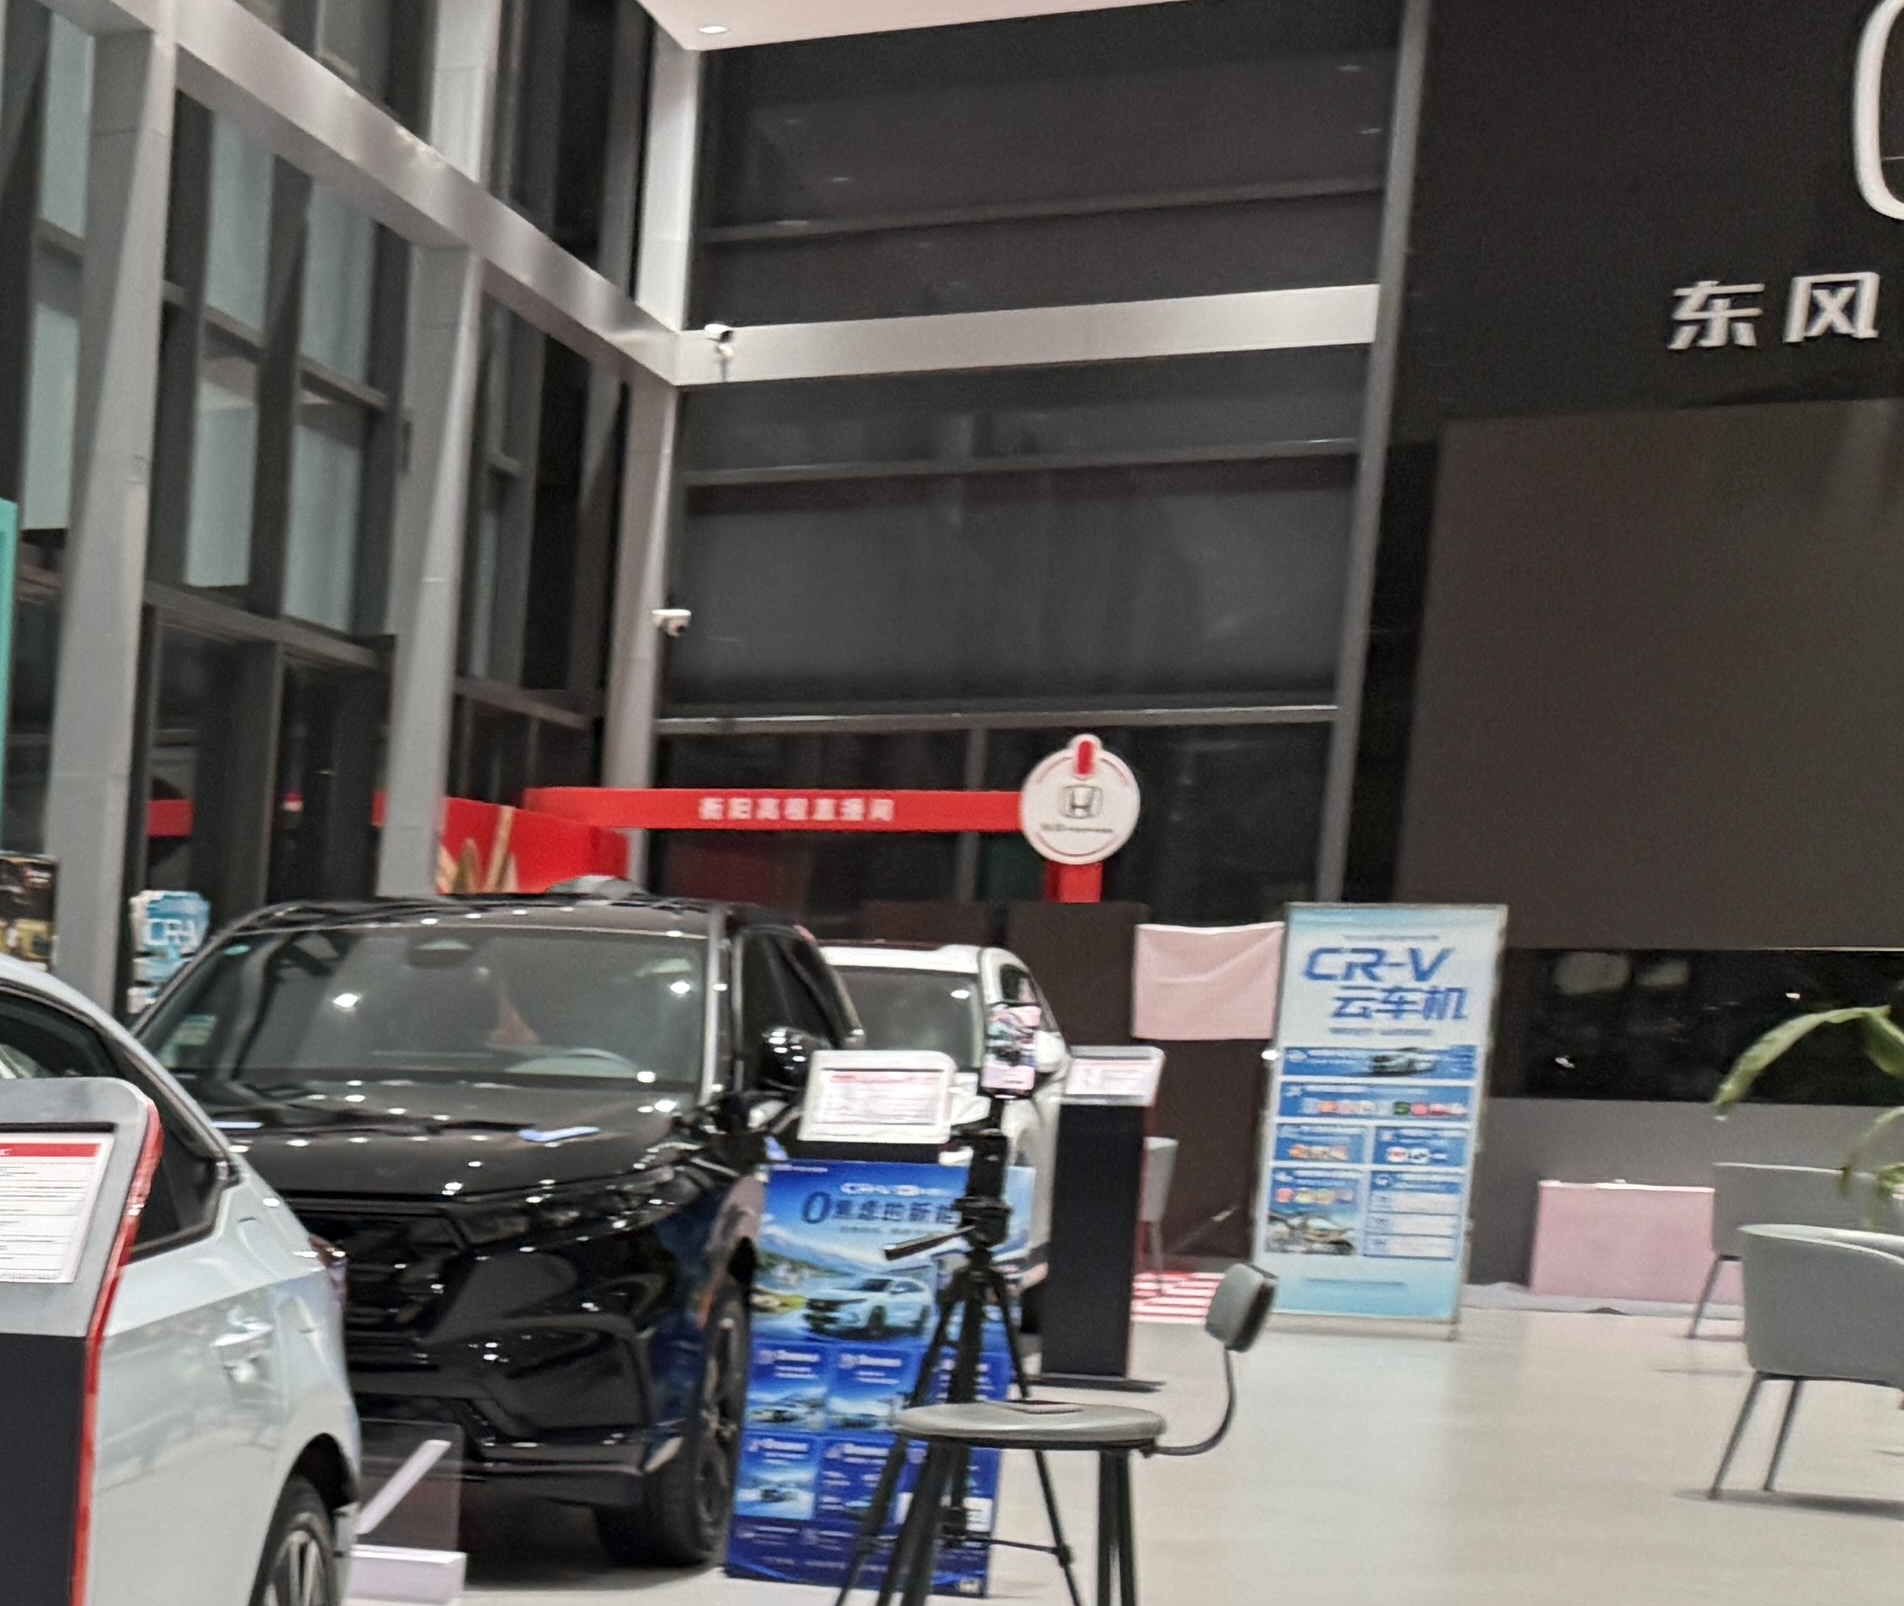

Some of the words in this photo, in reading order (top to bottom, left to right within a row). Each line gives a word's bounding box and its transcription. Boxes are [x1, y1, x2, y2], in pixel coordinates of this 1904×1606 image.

[1667, 271, 1880, 350] 东风
[1302, 946, 1457, 983] CR-V
[1330, 985, 1469, 1021] 云车机
